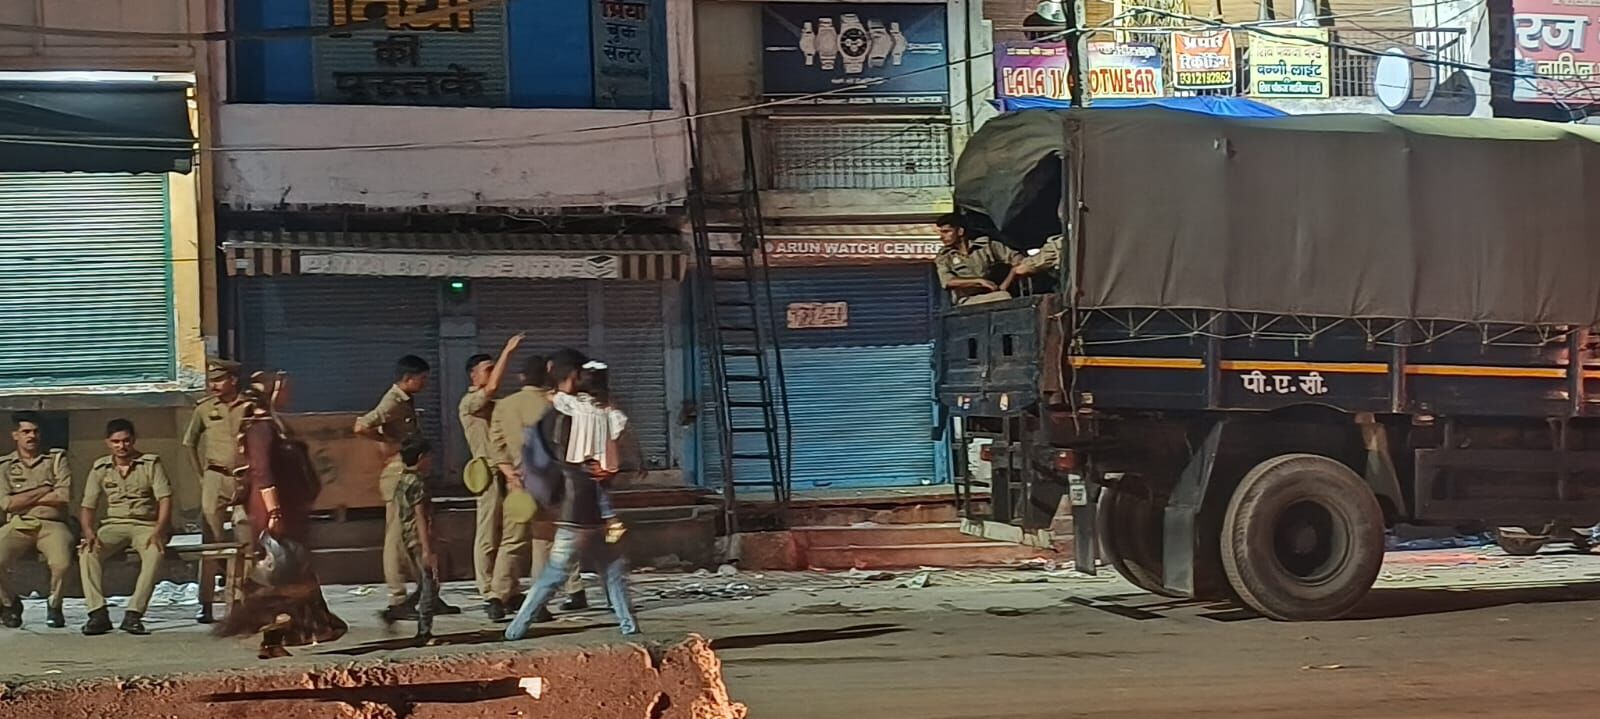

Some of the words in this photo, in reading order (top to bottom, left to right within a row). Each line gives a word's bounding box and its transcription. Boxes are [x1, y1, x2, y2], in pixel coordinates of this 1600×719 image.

[1003, 68, 1046, 97] LALA
[775, 242, 821, 253] ARUN
[824, 243, 878, 254] WATCH
